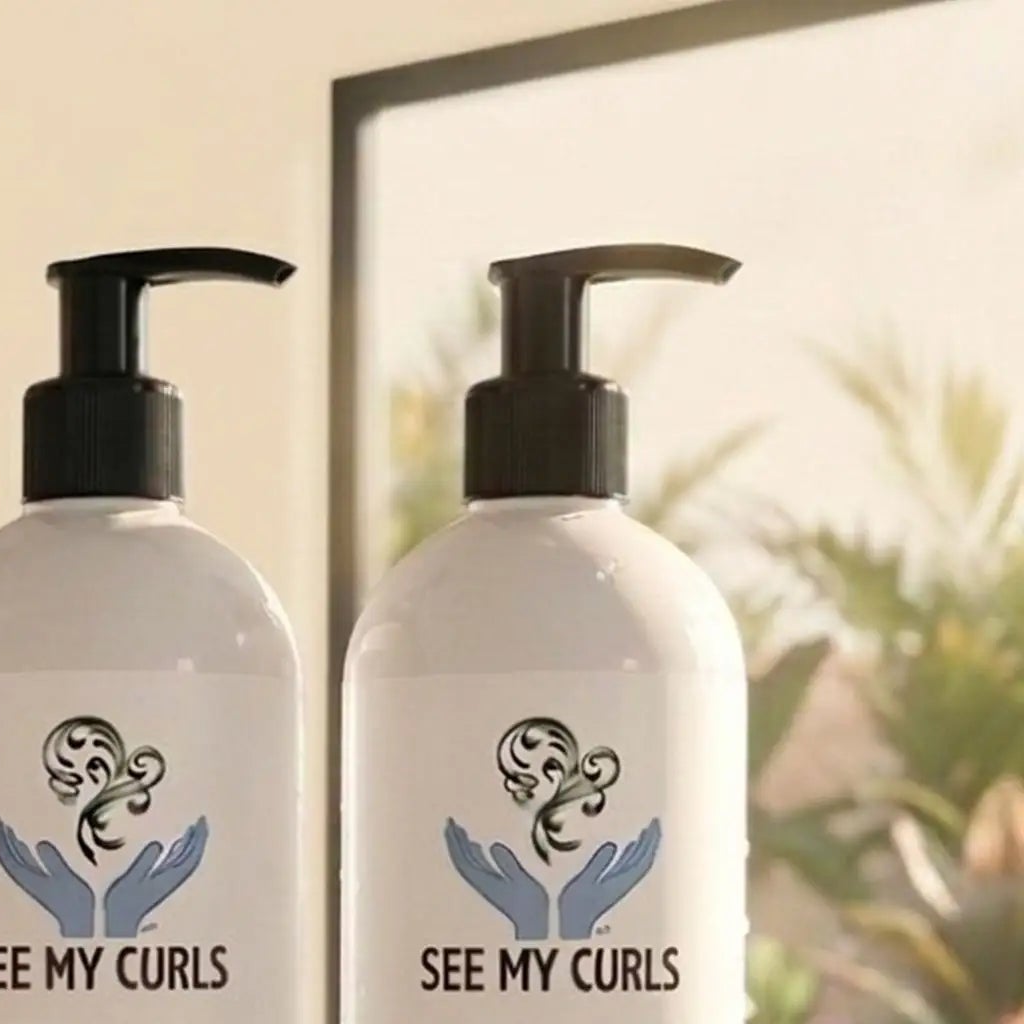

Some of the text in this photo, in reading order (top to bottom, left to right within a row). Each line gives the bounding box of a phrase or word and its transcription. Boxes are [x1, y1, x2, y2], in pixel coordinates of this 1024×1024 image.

[46, 946, 104, 990] MY
[116, 946, 229, 990] CURLS
[420, 947, 680, 992] SEE MY CURLS
